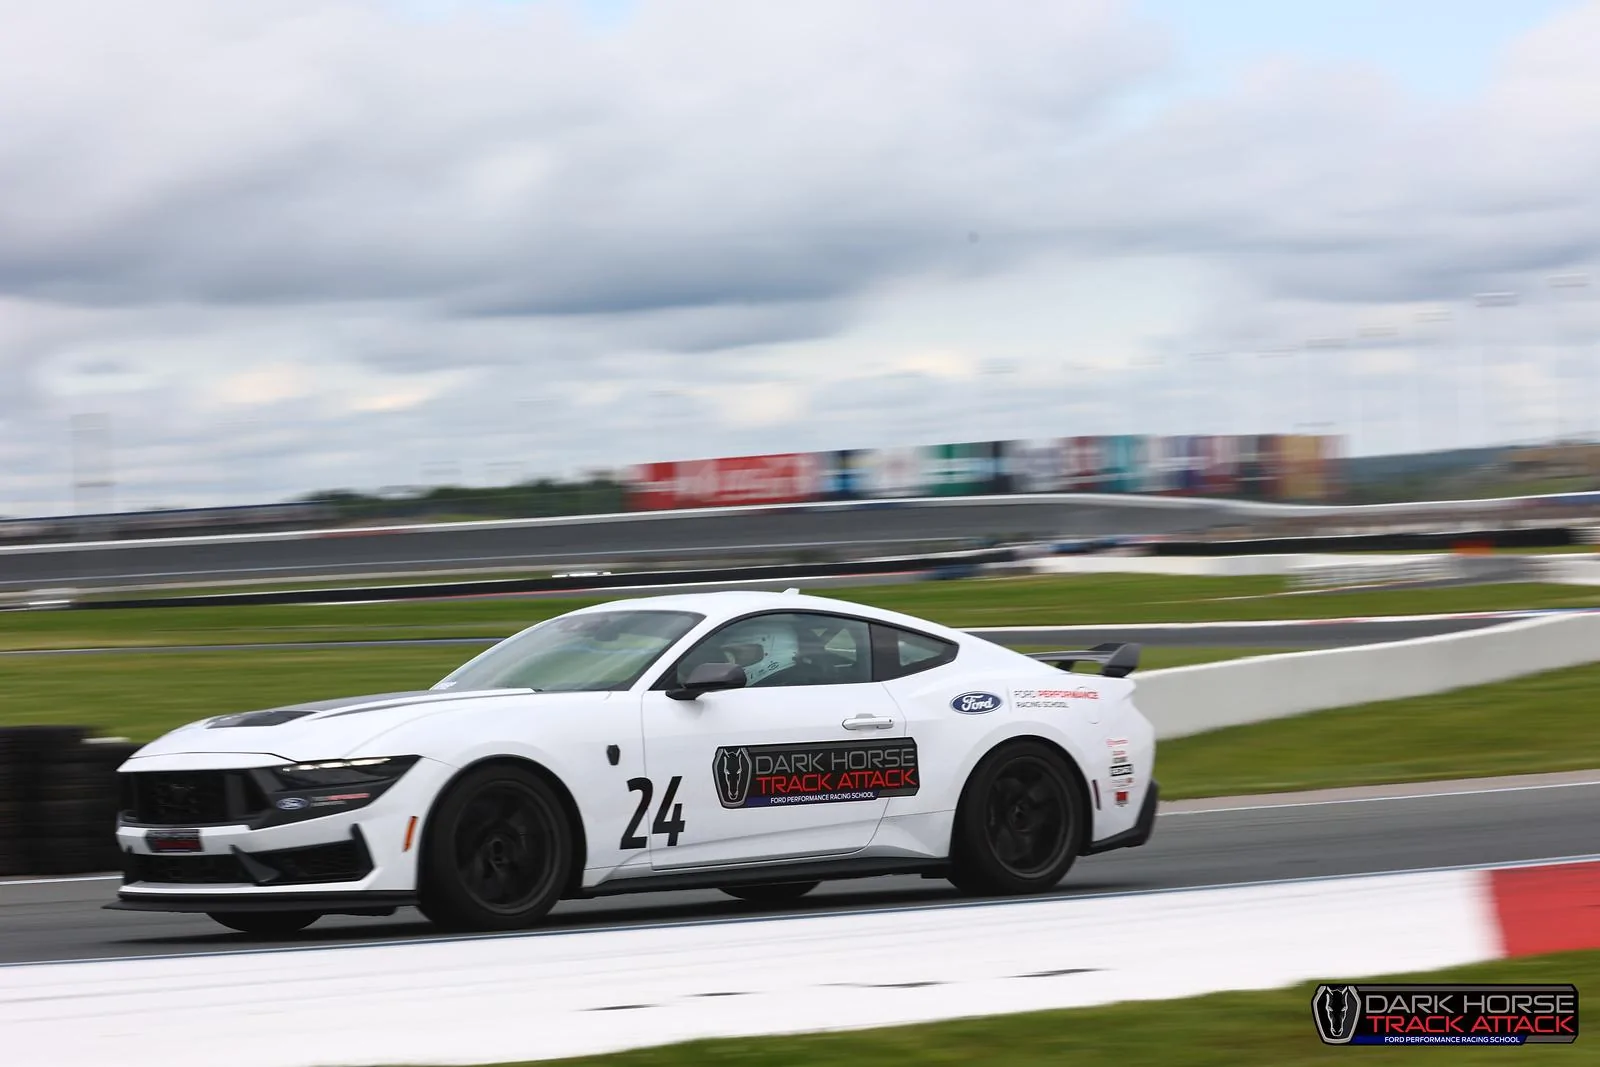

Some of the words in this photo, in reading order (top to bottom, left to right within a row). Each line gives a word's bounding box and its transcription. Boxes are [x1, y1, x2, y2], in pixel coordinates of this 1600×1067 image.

[961, 694, 994, 712] Ford
[755, 752, 825, 775] DARK
[831, 748, 915, 771] HORSE
[756, 772, 833, 795] TRACK
[837, 768, 917, 790] ATTACK
[787, 794, 830, 803] PERFORMANCE
[830, 792, 851, 801] RACING
[851, 791, 875, 799] SCHOOL
[619, 775, 686, 850] 24
